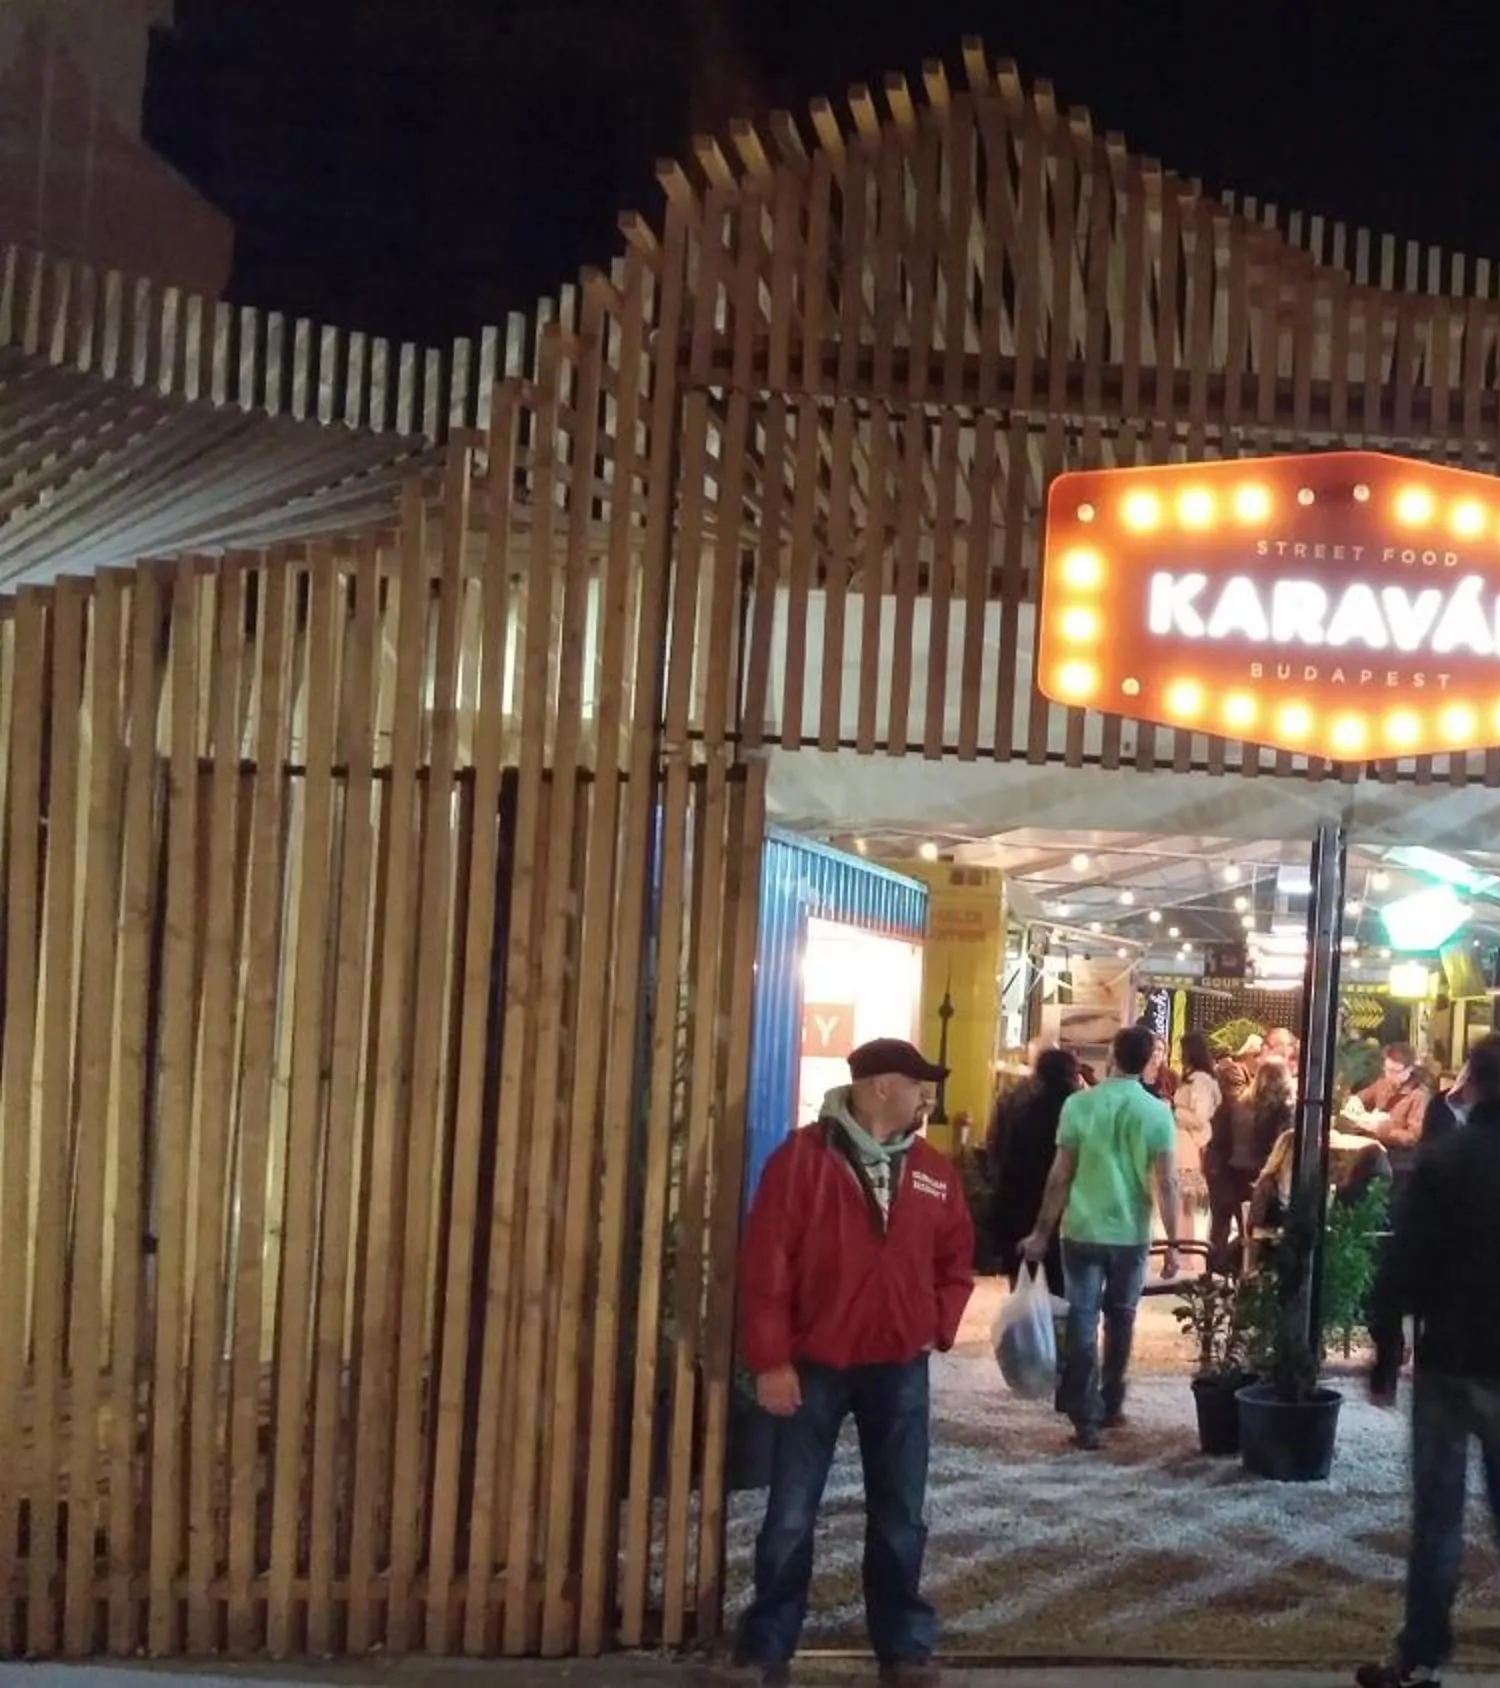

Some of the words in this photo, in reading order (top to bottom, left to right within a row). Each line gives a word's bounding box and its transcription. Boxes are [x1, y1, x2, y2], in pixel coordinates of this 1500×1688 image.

[1256, 540, 1366, 561] STREET
[1383, 547, 1458, 567] FOOD
[1250, 662, 1451, 688] BUDAPEST
